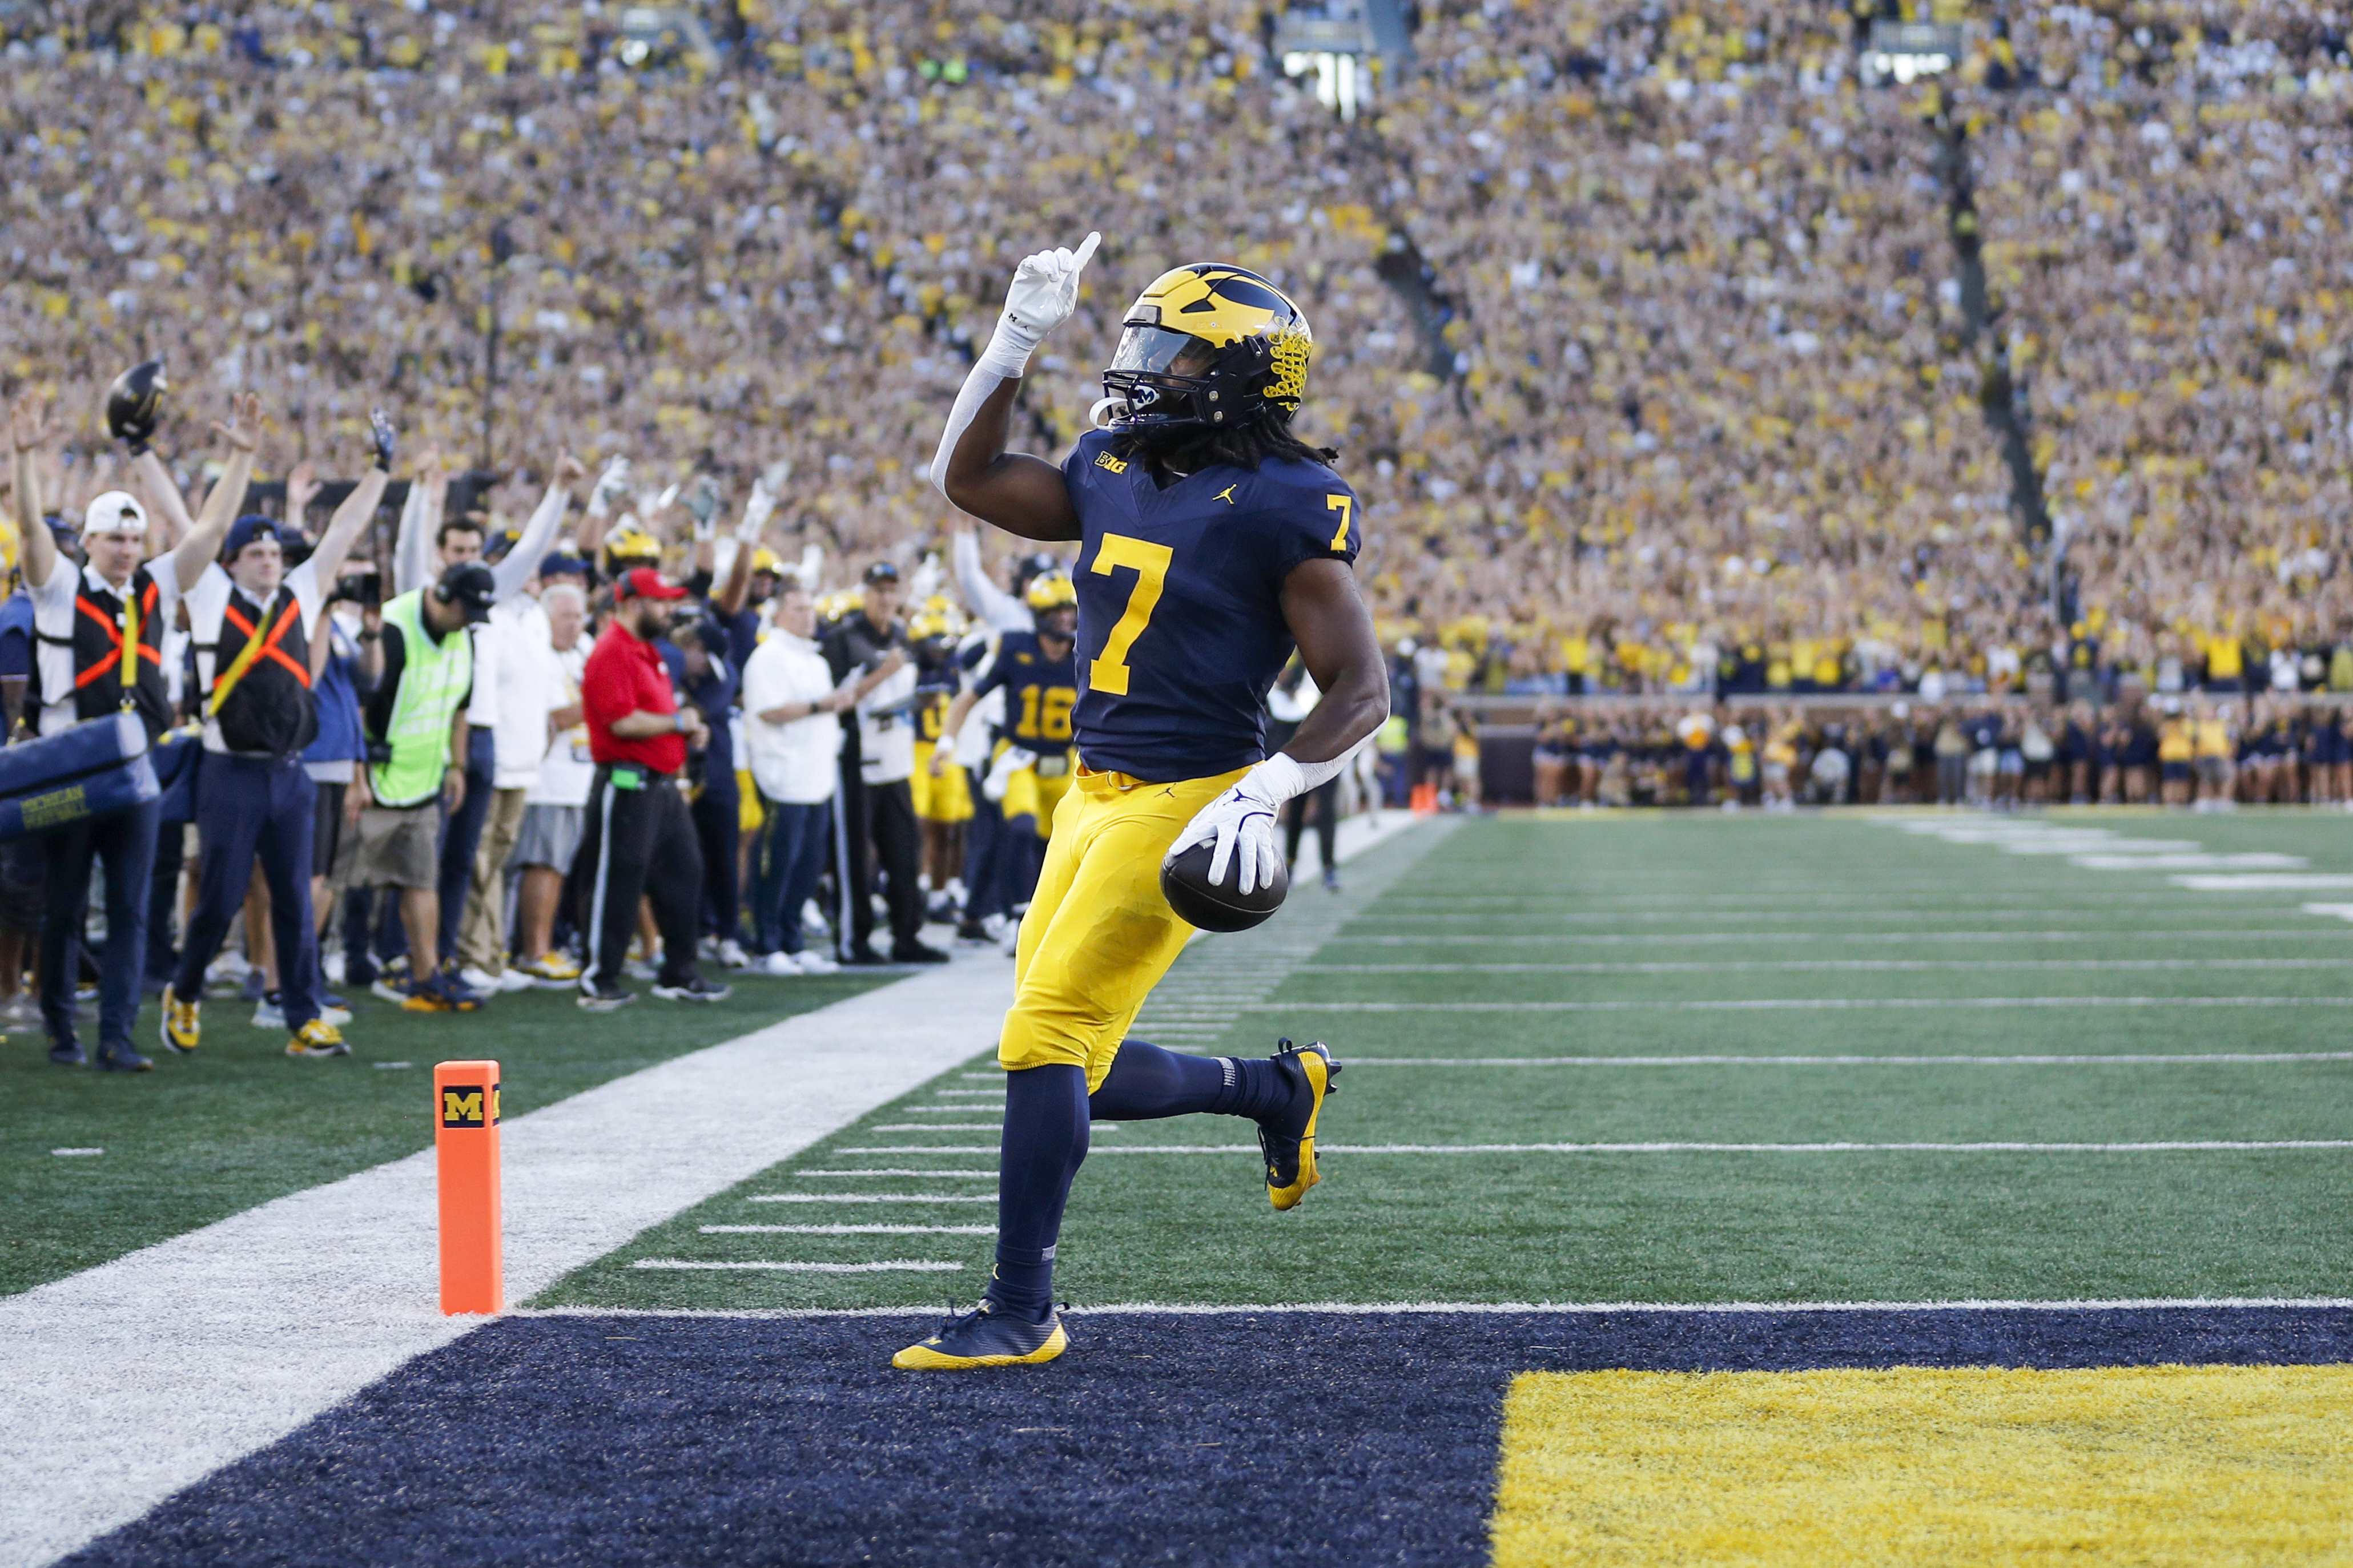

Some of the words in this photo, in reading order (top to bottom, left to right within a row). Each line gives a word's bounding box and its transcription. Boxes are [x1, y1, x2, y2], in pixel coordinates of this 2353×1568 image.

[1137, 389, 1155, 404] M
[1326, 494, 1352, 551] 7
[1089, 533, 1173, 695] 7
[1016, 684, 1077, 739] 16
[444, 1092, 483, 1120] M
